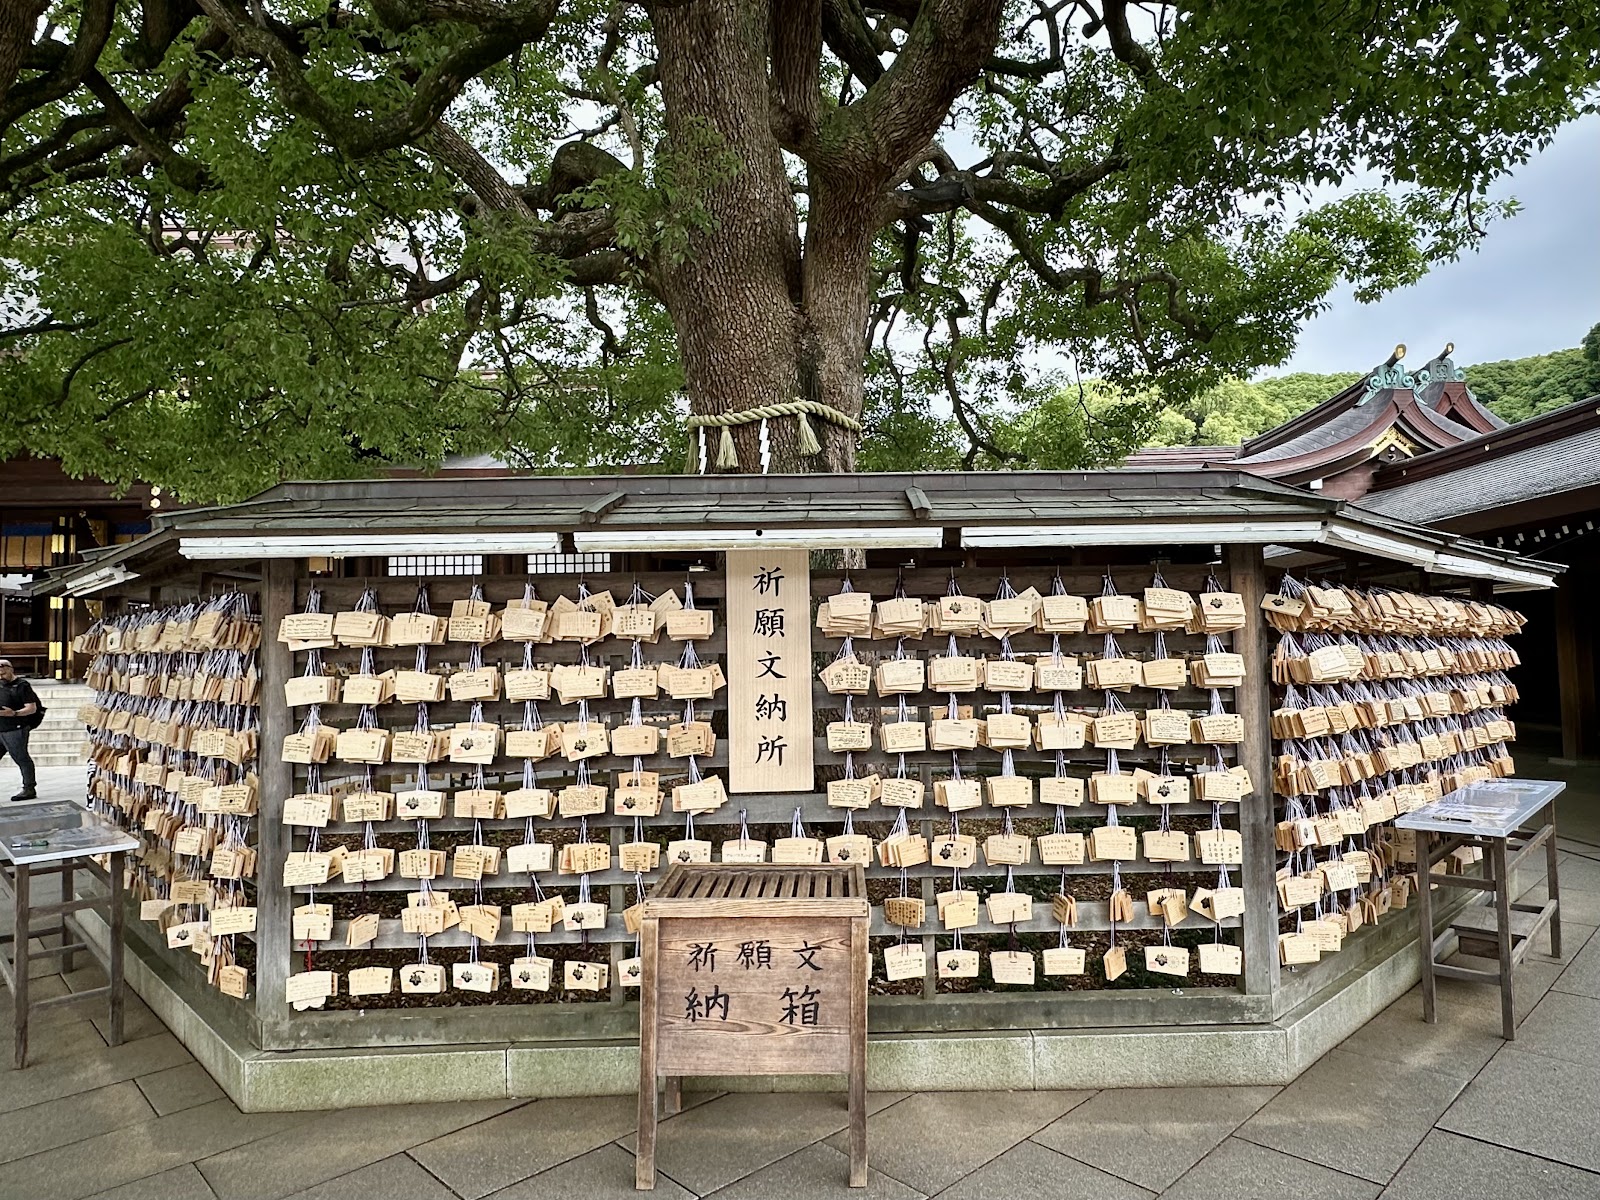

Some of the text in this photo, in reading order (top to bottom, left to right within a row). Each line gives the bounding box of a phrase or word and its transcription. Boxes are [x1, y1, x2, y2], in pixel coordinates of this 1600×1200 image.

[752, 566, 788, 767] 祈願文納所
[686, 939, 824, 973] 祈願文
[684, 984, 822, 1026] 納箱
